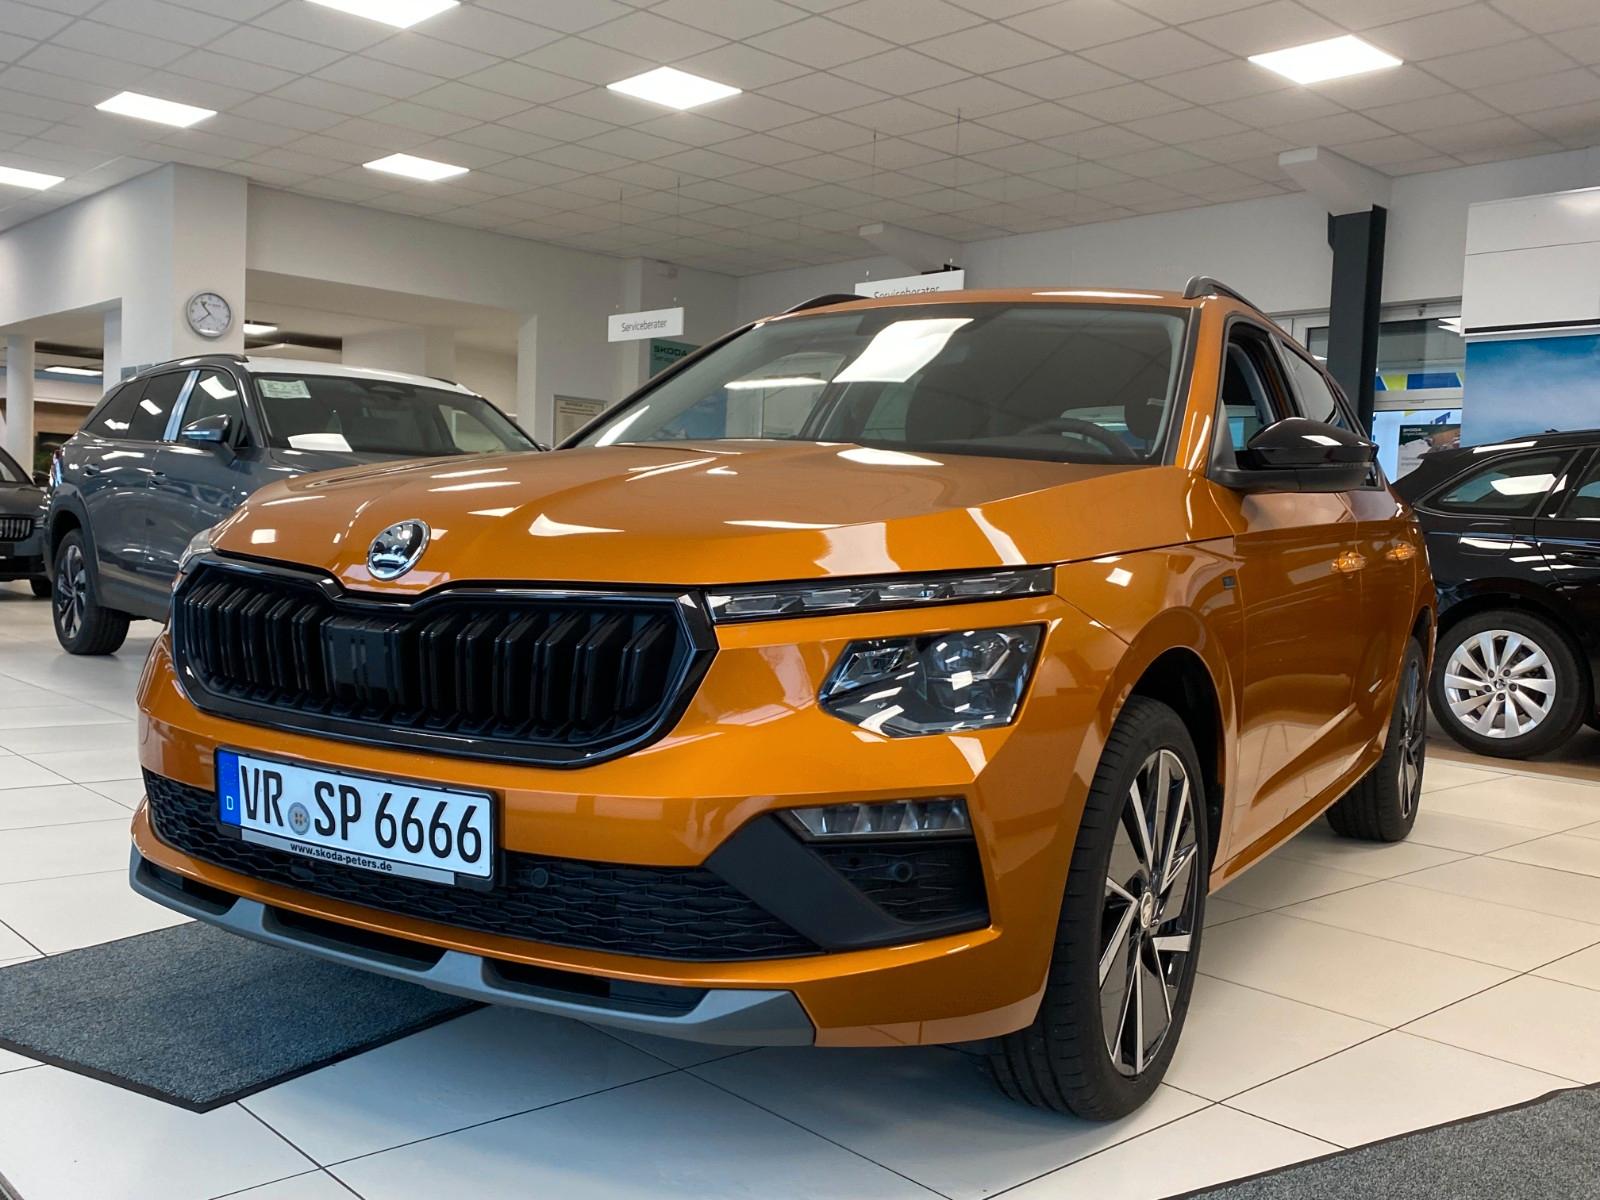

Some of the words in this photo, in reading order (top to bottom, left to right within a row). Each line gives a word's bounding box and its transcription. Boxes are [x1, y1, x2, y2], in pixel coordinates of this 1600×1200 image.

[620, 319, 668, 333] Serviceberater
[226, 796, 234, 811] D
[241, 765, 284, 827] VR
[314, 781, 361, 840] SP
[375, 792, 482, 864] 6666
[290, 842, 393, 872] www.skoda-peters.de
